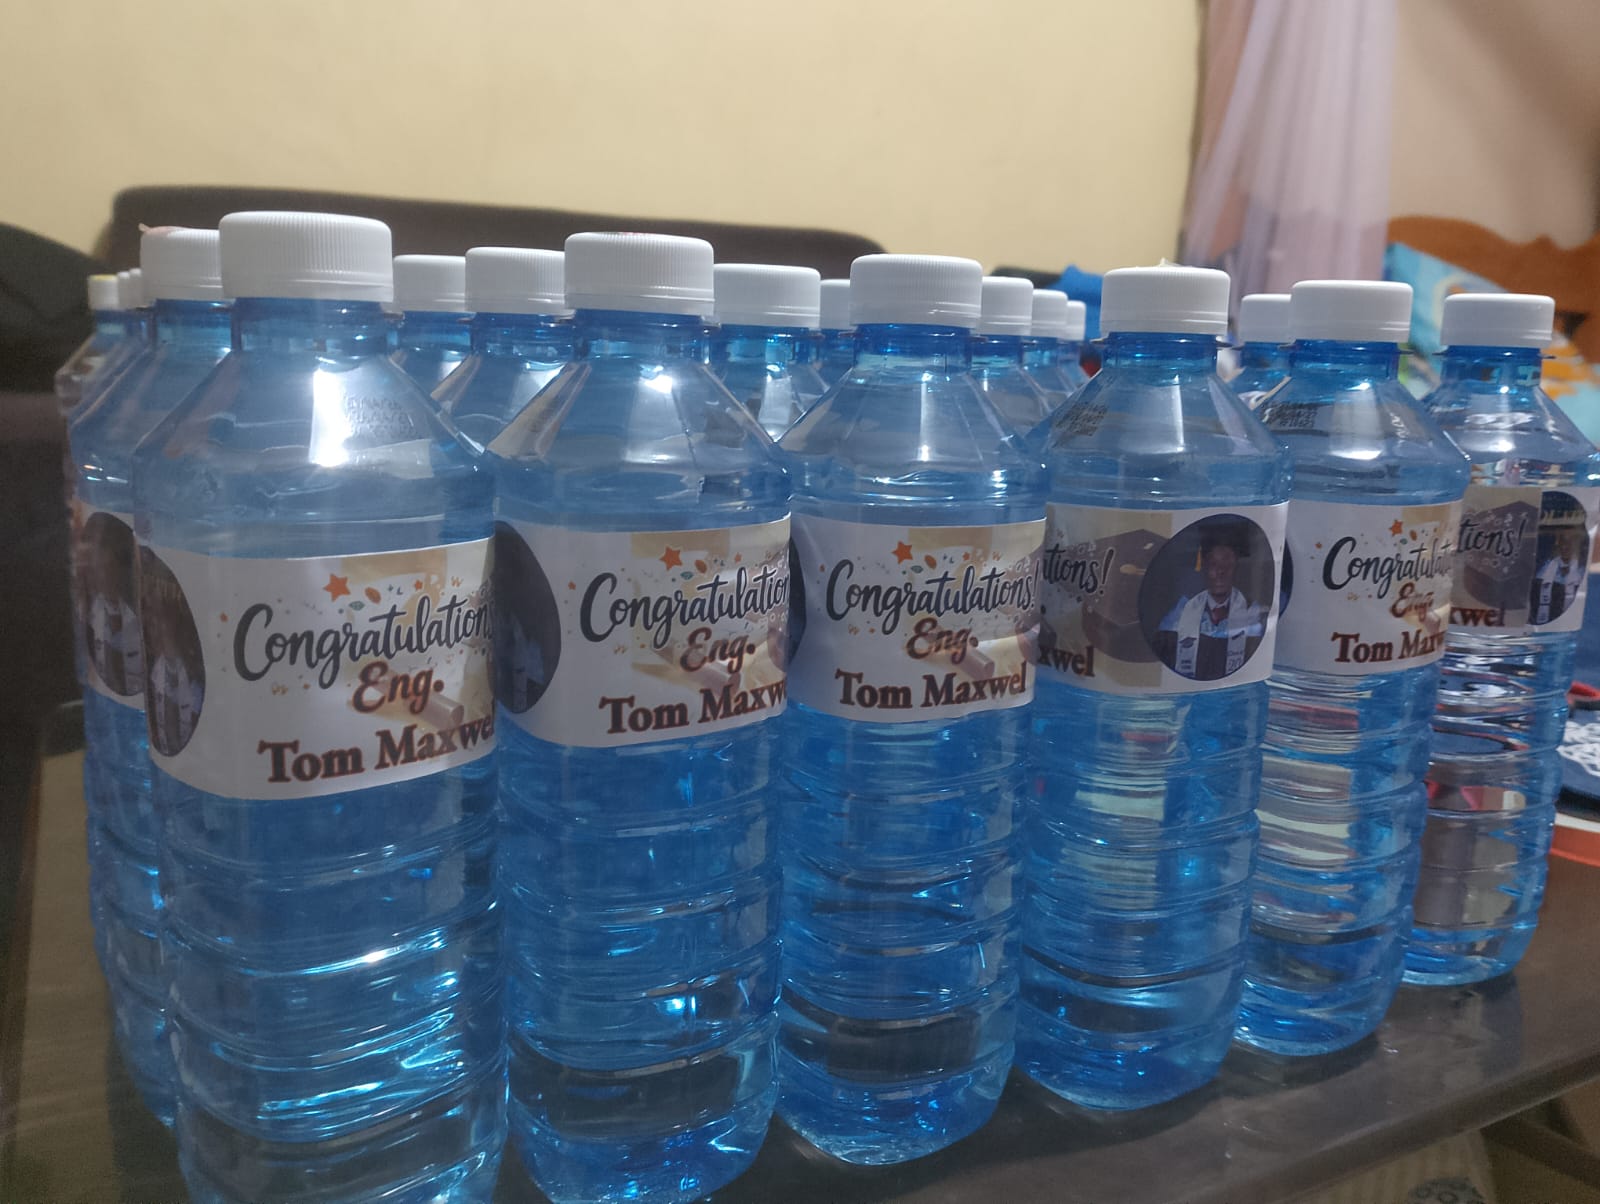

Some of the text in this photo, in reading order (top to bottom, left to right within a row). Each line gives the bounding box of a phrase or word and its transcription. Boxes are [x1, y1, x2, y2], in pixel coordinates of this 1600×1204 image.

[1042, 543, 1114, 595] tions!
[826, 558, 1040, 635] Congratulations!
[232, 595, 494, 689] Congratulation
[679, 626, 756, 674] Eng.
[906, 617, 979, 664] Eng.
[1331, 632, 1394, 663] Tom
[351, 661, 445, 715] Eng.
[598, 678, 788, 735] Tom Maxw
[835, 660, 1028, 710] Tom Maxwel
[256, 739, 365, 784] Tom
